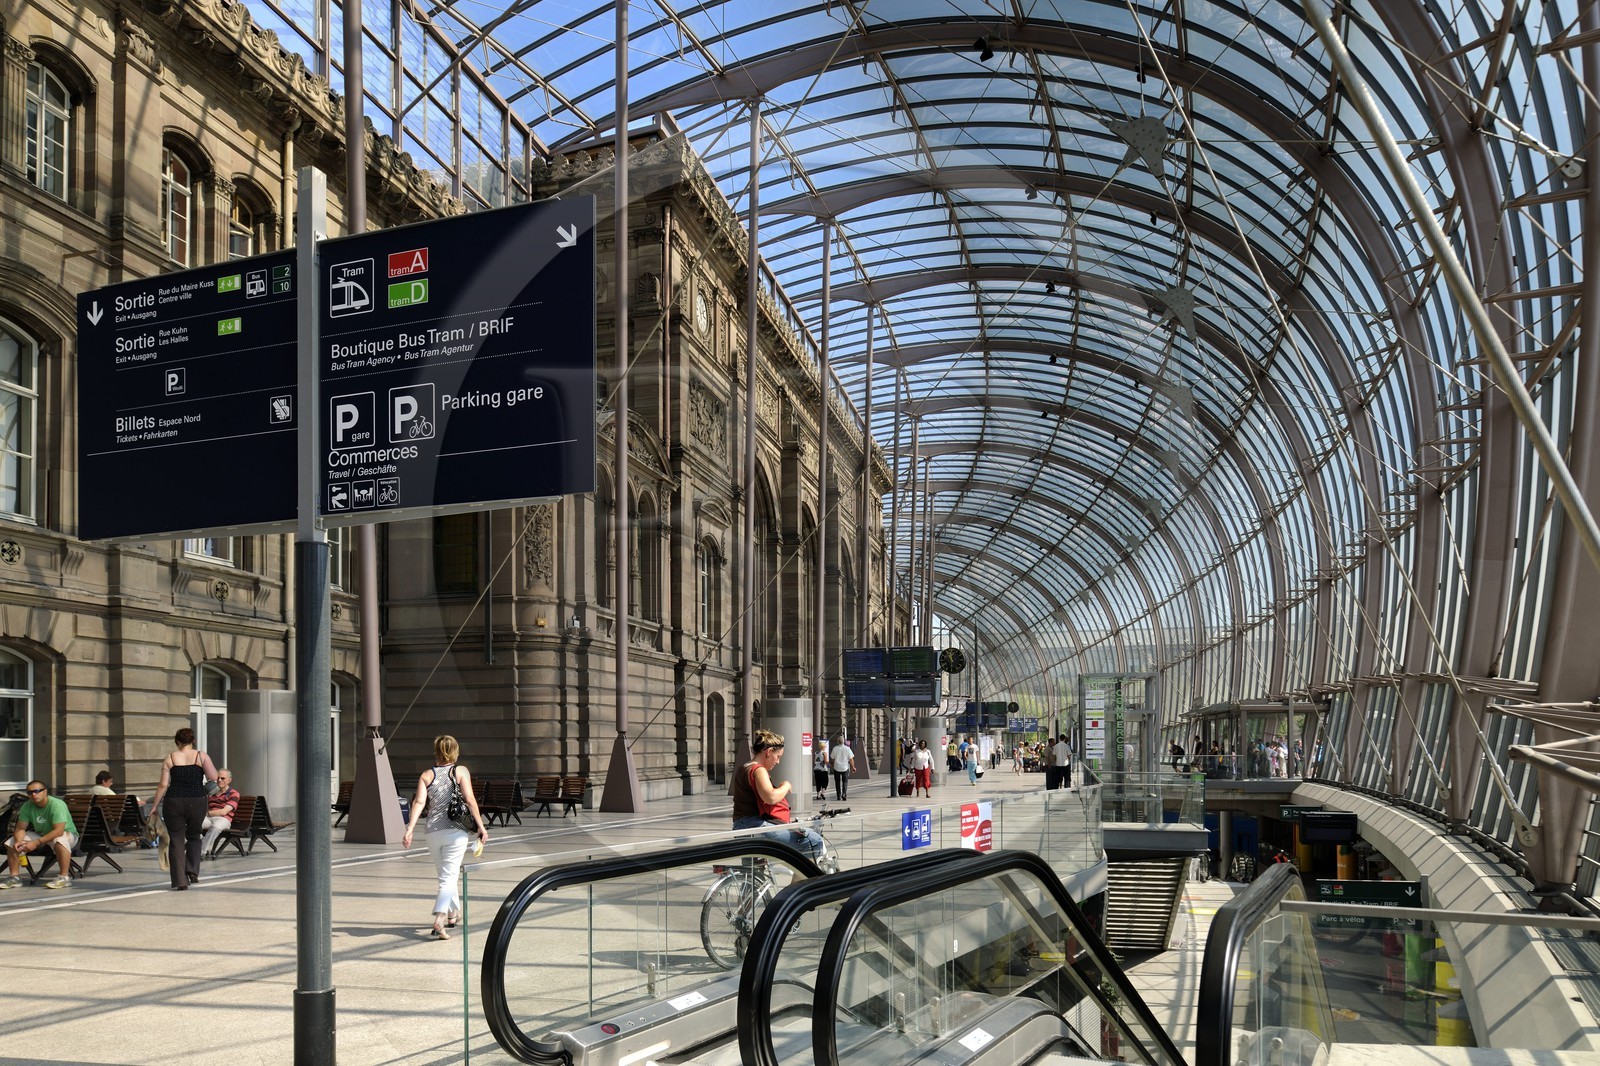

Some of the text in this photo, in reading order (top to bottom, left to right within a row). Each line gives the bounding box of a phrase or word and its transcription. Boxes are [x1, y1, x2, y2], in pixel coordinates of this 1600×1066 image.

[284, 266, 290, 276] 2
[341, 267, 364, 277] Tram
[171, 286, 180, 294] du
[180, 283, 198, 292] Maire
[199, 280, 214, 289] Kuss
[280, 281, 290, 291] 10
[115, 292, 155, 312] Sortie
[158, 296, 178, 304] Centre
[115, 310, 157, 323] Exit Ausgang
[172, 326, 188, 335] Kuhn
[331, 339, 394, 359] Boutique
[479, 316, 514, 336] BRIF
[115, 333, 155, 353] Sortie
[170, 335, 189, 344] Halles
[440, 344, 474, 356] Agentur
[116, 352, 157, 364] Exit Ausgang
[366, 355, 396, 367] Agency
[168, 373, 179, 392] P
[442, 386, 544, 411] Parking gare
[394, 395, 418, 435] P
[116, 414, 201, 433] Billets Espace Nord
[336, 403, 360, 442] P
[116, 429, 178, 444] Tickets Fahrkarten
[351, 431, 370, 442] gare
[328, 445, 419, 467] Commerces
[328, 468, 351, 480] Travel
[357, 464, 397, 476] Geschäfte
[1116, 689, 1124, 759] COMMERCES
